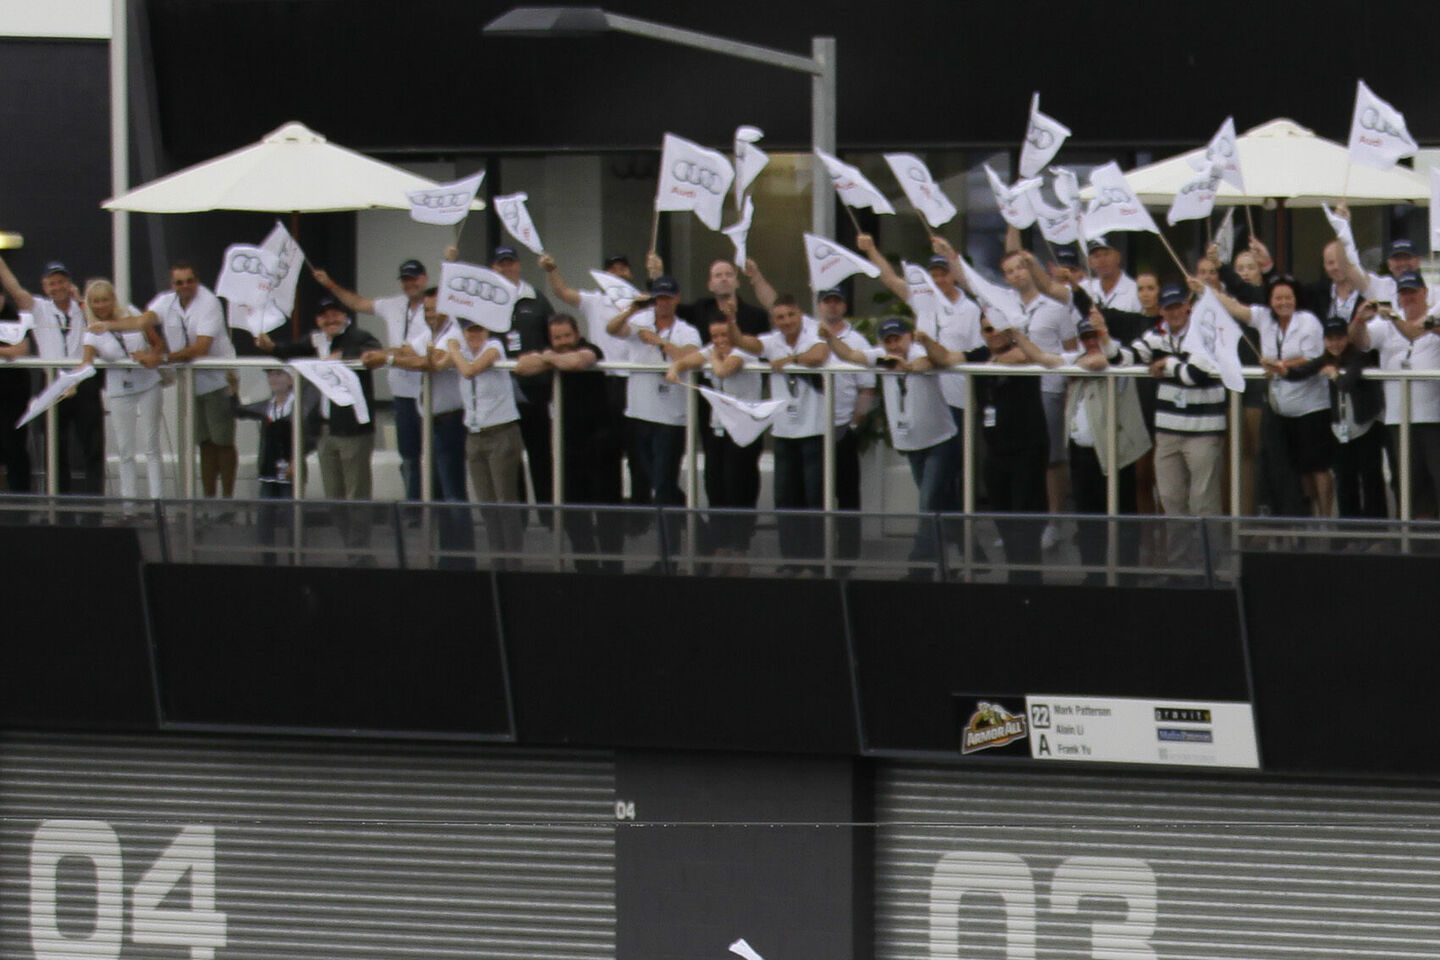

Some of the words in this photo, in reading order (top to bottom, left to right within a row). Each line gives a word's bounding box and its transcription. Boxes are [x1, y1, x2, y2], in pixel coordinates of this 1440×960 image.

[1032, 705, 1049, 727] 22
[1039, 733, 1051, 755] A
[615, 801, 635, 820] 04
